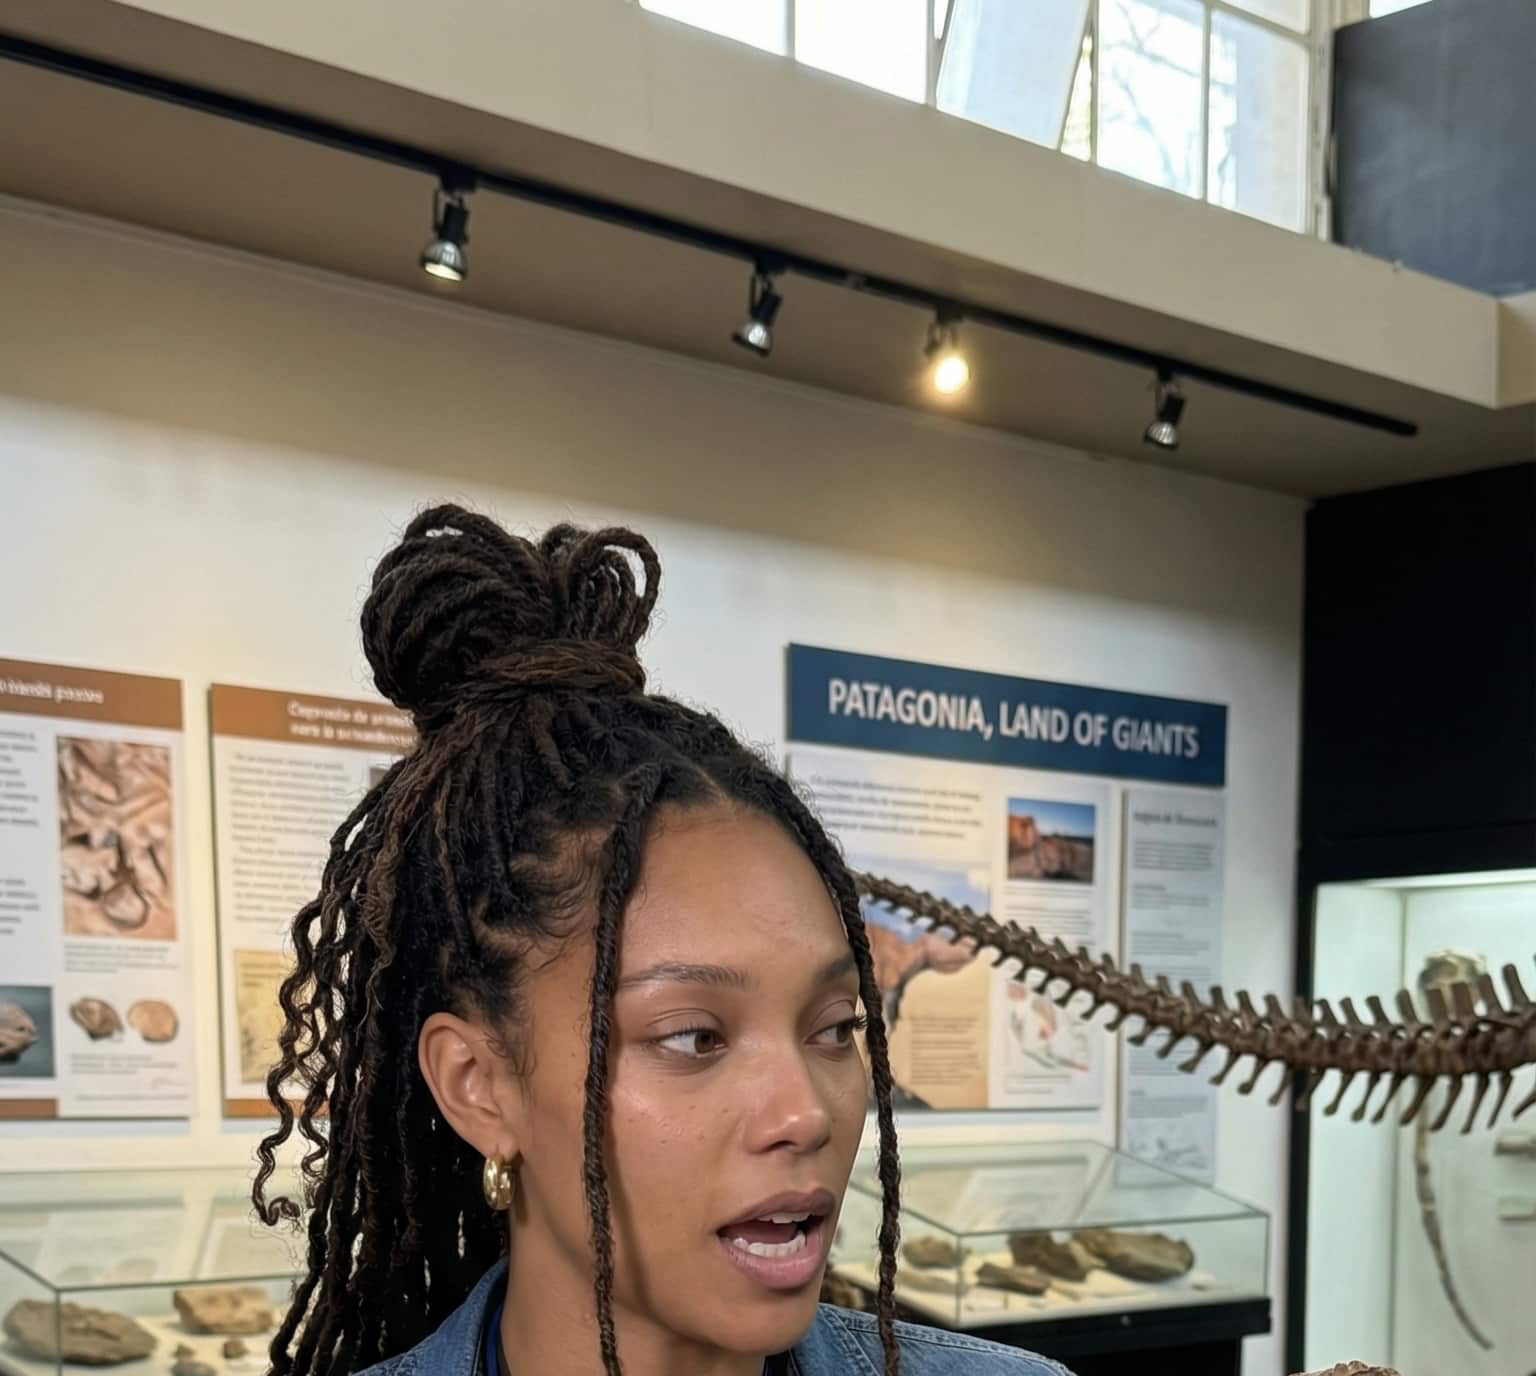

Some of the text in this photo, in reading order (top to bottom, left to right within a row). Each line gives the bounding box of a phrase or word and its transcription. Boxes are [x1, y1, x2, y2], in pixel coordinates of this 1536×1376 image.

[828, 678, 1200, 760] PATAGONIA, LAND OF GIANTS
